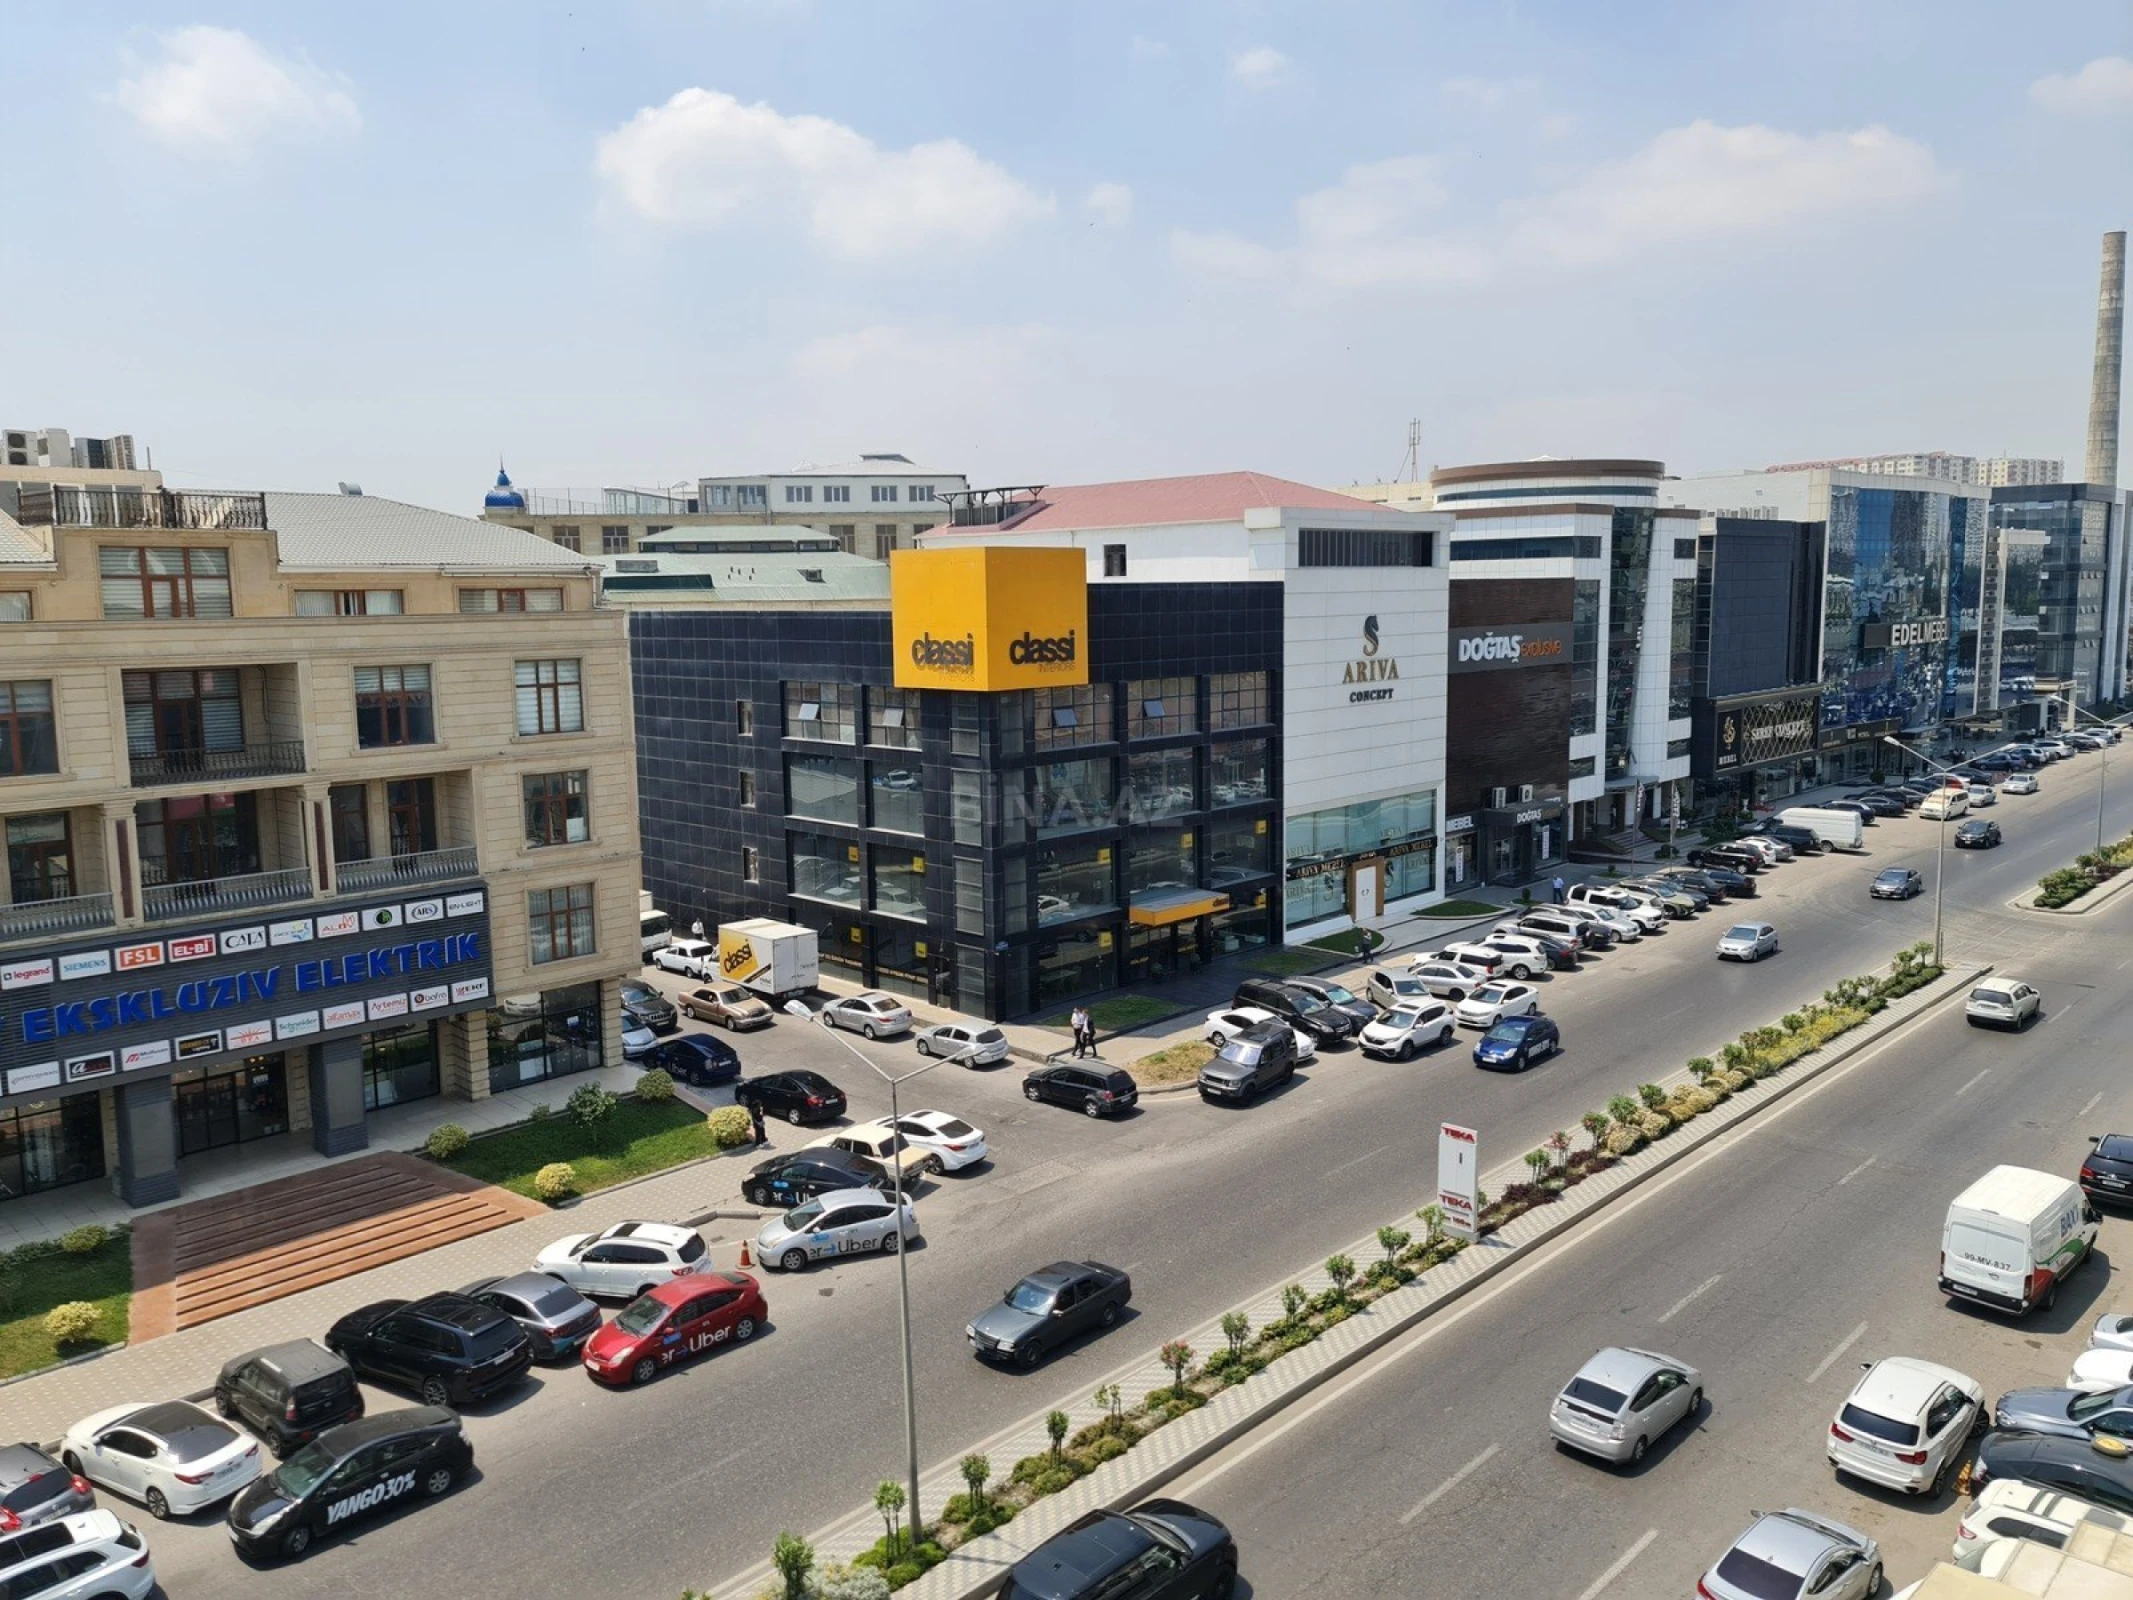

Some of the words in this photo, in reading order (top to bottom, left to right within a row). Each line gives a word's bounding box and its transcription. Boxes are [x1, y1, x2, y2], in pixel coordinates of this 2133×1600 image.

[912, 631, 974, 665] classi
[1009, 629, 1075, 664] classi
[1458, 632, 1523, 663] DOĞTAŞ
[1342, 659, 1399, 684] ARIVA
[1350, 688, 1394, 703] CONCEPT
[123, 949, 157, 965] FSL
[724, 938, 752, 974] classi
[13, 966, 50, 979] legrand
[63, 959, 107, 972] SIEMENS
[1442, 1127, 1475, 1144] TEKA
[1439, 1194, 1473, 1211] TEKA
[838, 1237, 878, 1253] Uber
[689, 1326, 731, 1352] Uber
